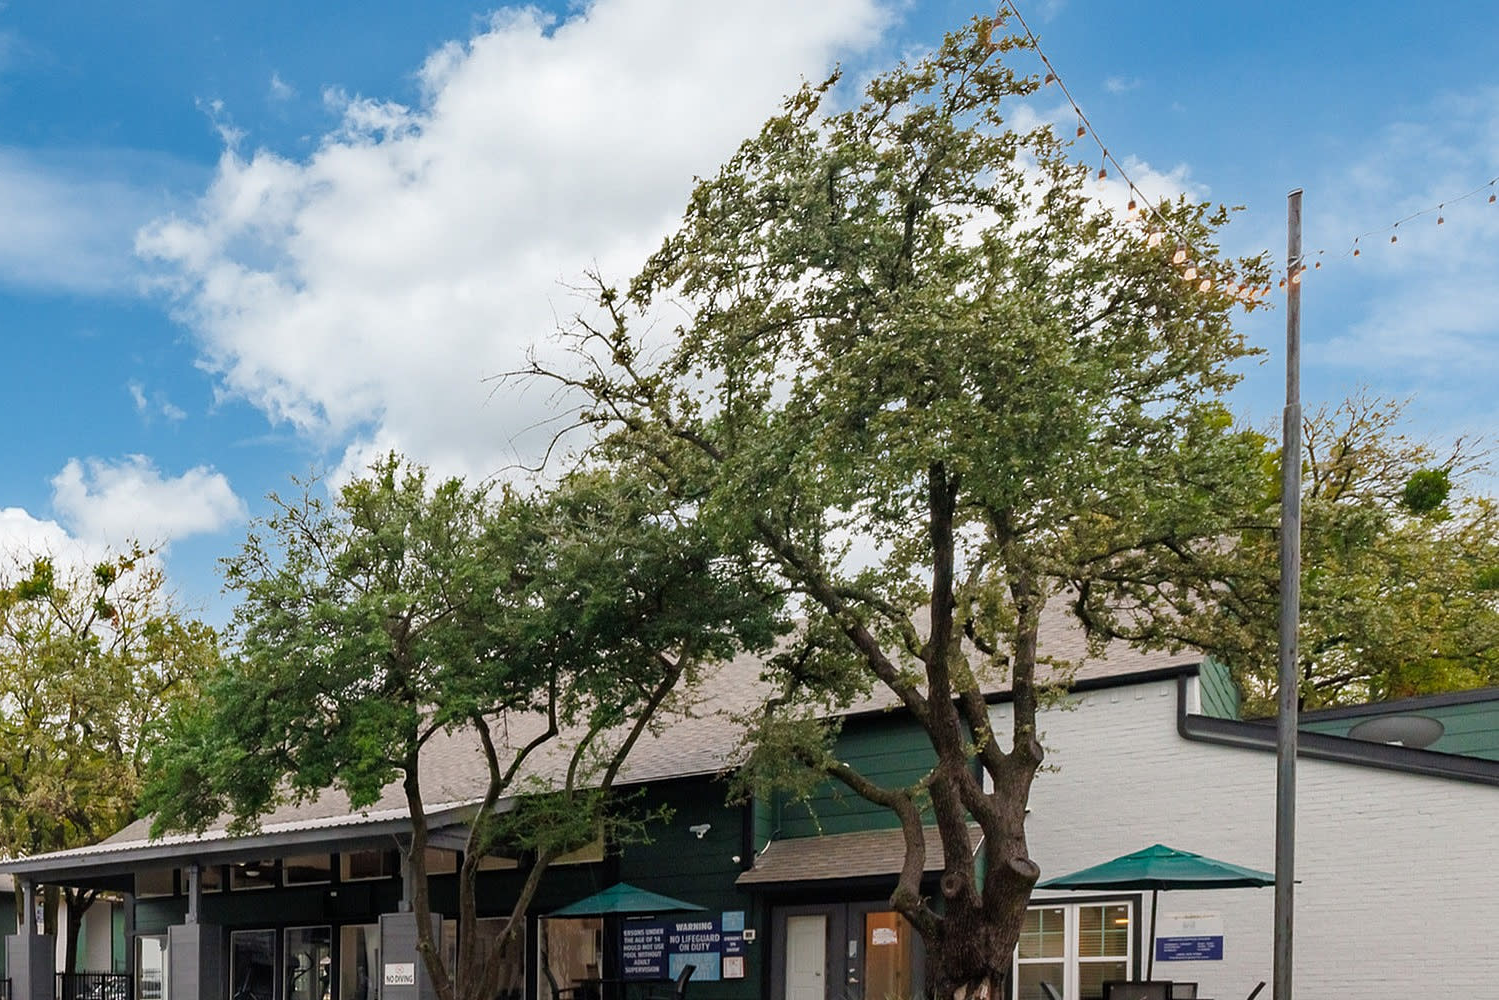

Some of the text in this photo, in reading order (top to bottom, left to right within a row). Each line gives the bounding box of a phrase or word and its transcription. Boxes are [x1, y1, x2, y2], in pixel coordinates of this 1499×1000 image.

[676, 922, 712, 932] WARNING
[669, 935, 680, 944] NO
[681, 933, 720, 943] LIFEGUARD
[679, 942, 710, 952] ON DUTY
[386, 975, 413, 983] NO DIVING
